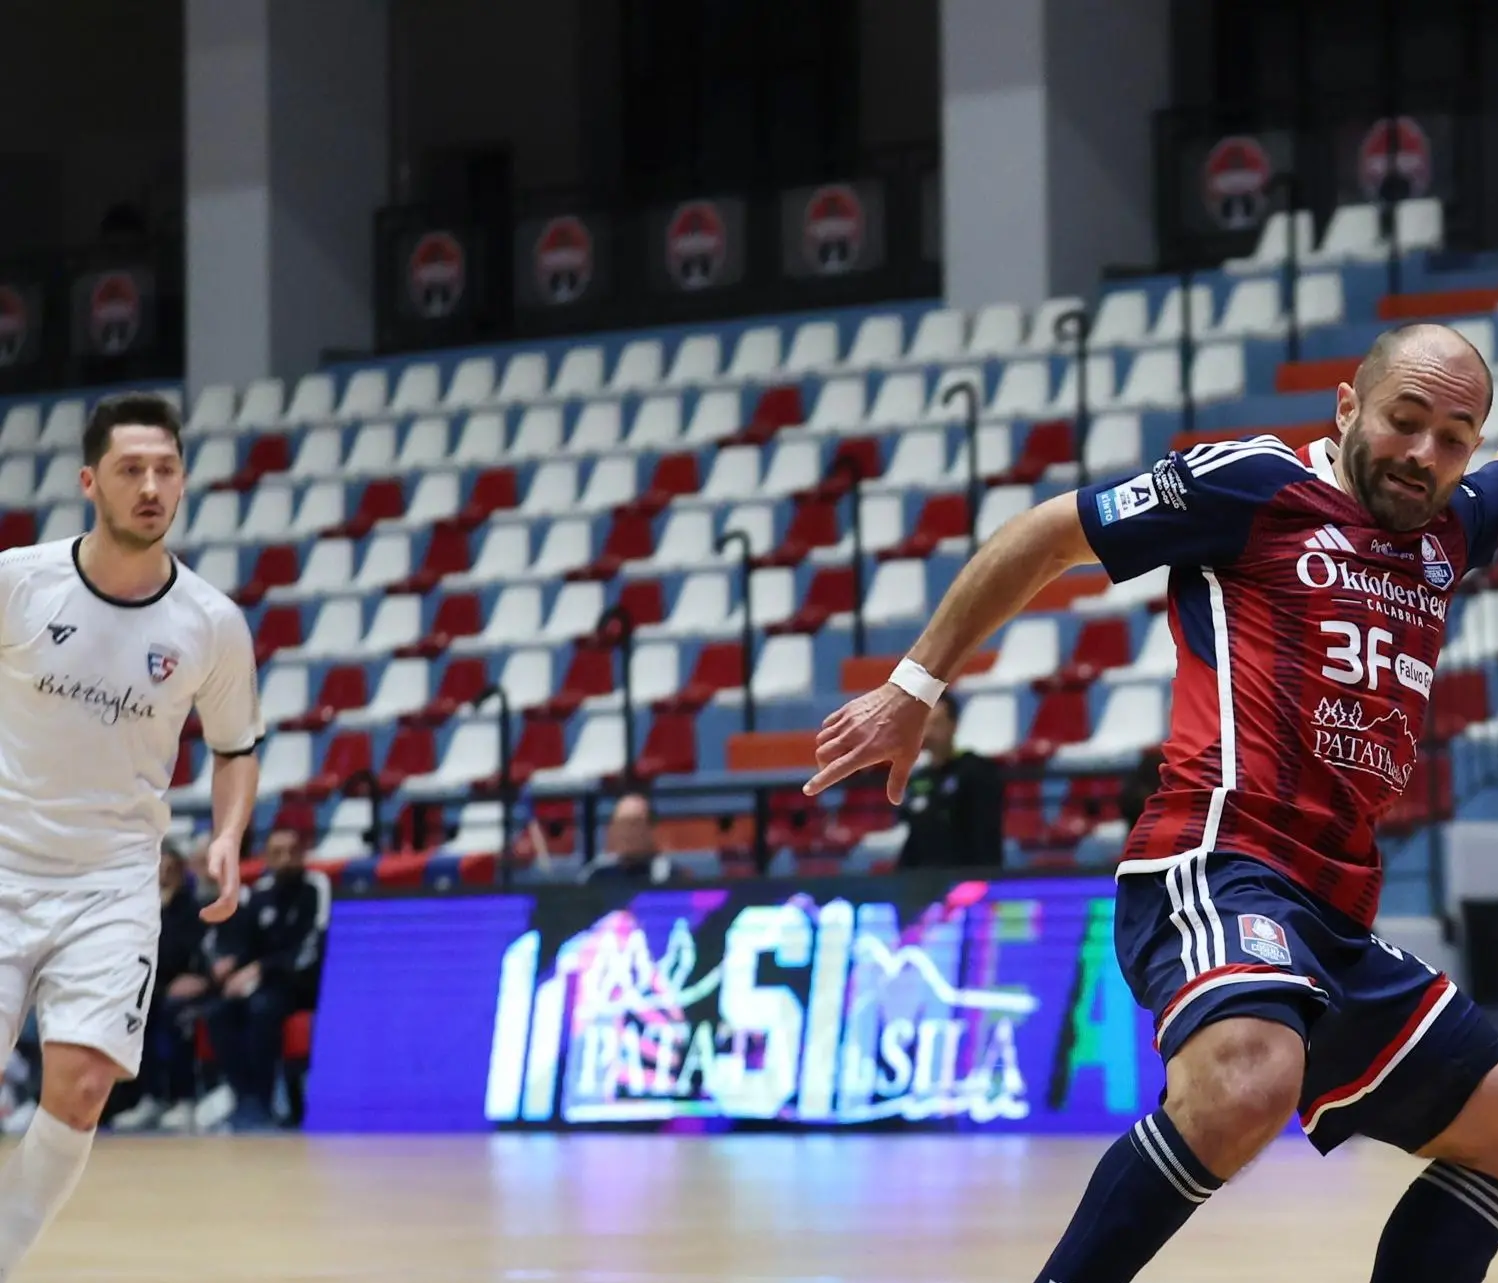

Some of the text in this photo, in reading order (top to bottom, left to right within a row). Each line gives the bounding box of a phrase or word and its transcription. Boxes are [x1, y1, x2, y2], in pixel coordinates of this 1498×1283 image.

[1131, 486, 1152, 507] A
[1366, 599, 1424, 628] CALABRIA
[1320, 620, 1393, 691] 3F
[1399, 659, 1423, 684] Falvo
[1313, 729, 1392, 775] PATATA
[136, 954, 152, 1010] 7
